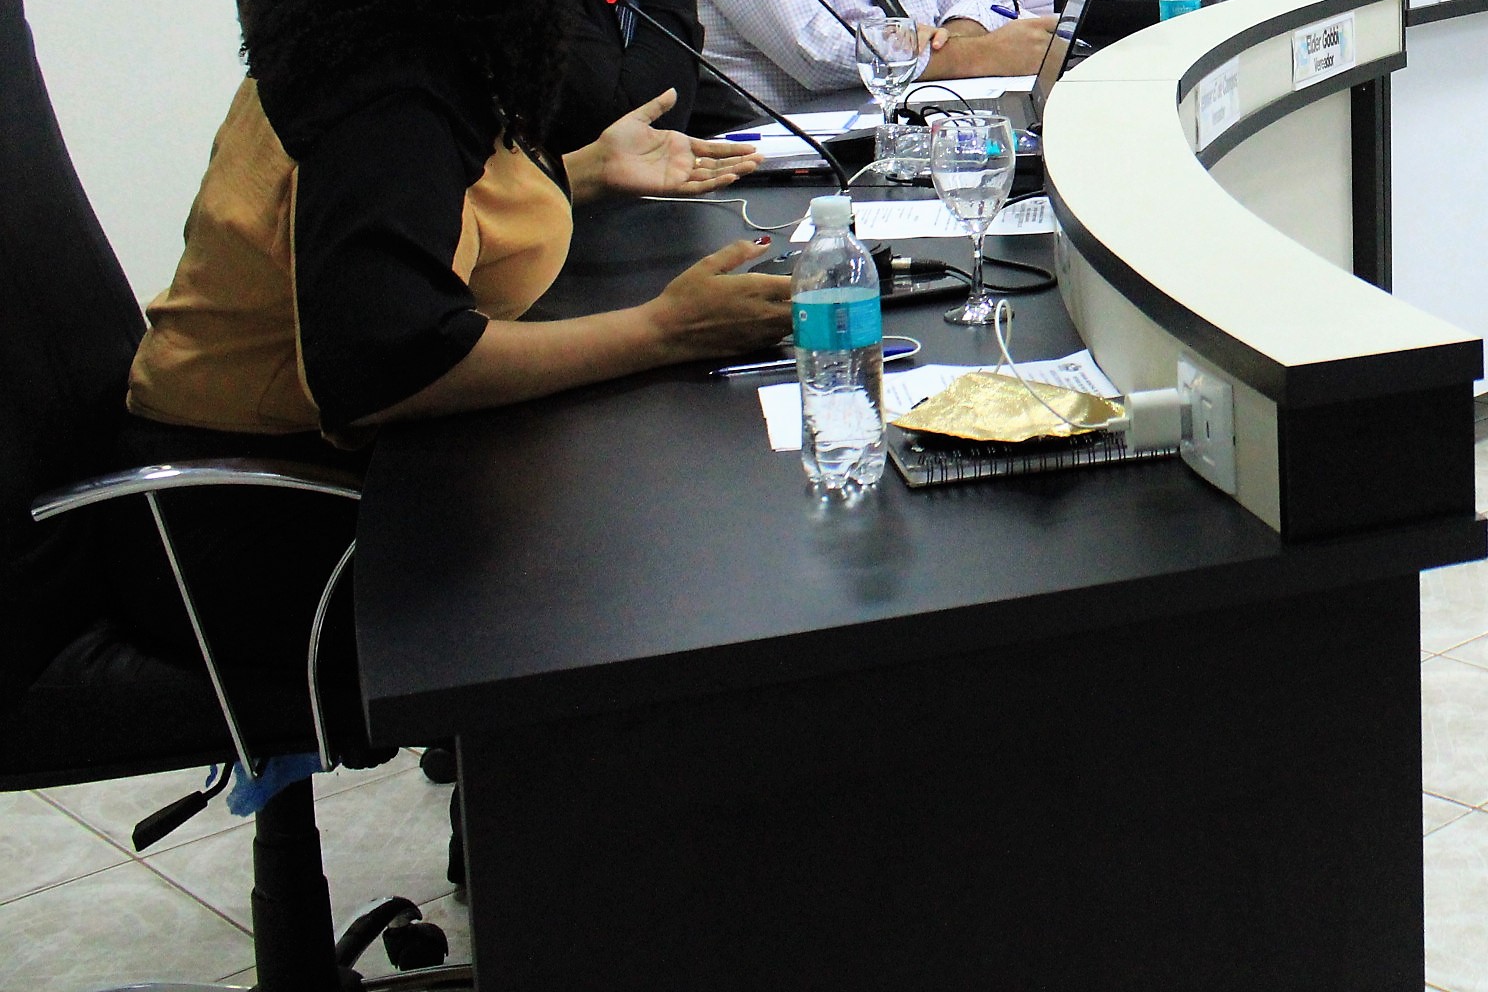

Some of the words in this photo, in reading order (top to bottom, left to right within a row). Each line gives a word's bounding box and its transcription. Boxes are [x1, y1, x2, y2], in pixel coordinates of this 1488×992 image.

[1306, 34, 1321, 55] Elder
[1322, 26, 1340, 50] Gobbi
[1314, 54, 1335, 72] Vereador
